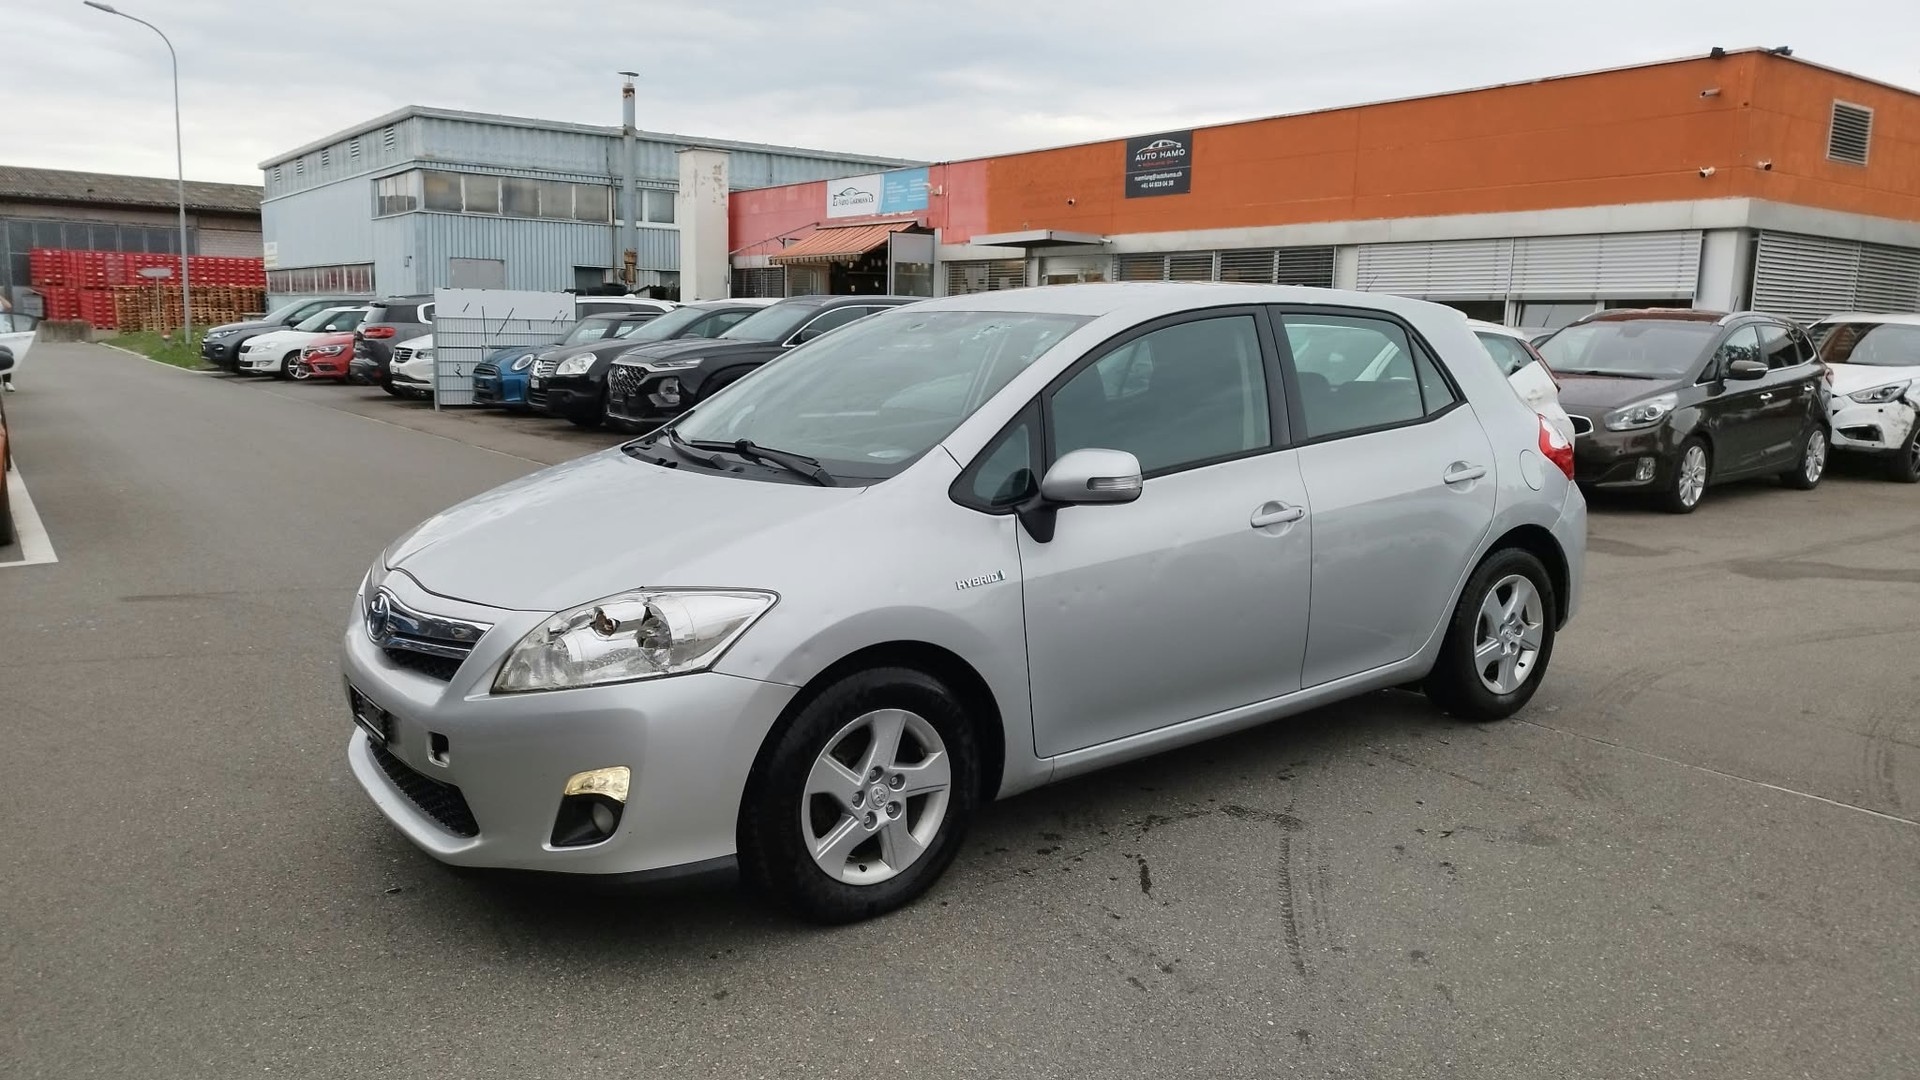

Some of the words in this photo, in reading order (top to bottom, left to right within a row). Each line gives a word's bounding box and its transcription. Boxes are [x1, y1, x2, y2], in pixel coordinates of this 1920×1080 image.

[1135, 152, 1157, 161] AUTO
[1160, 149, 1185, 158] HAMO
[956, 574, 999, 590] HYBRID
